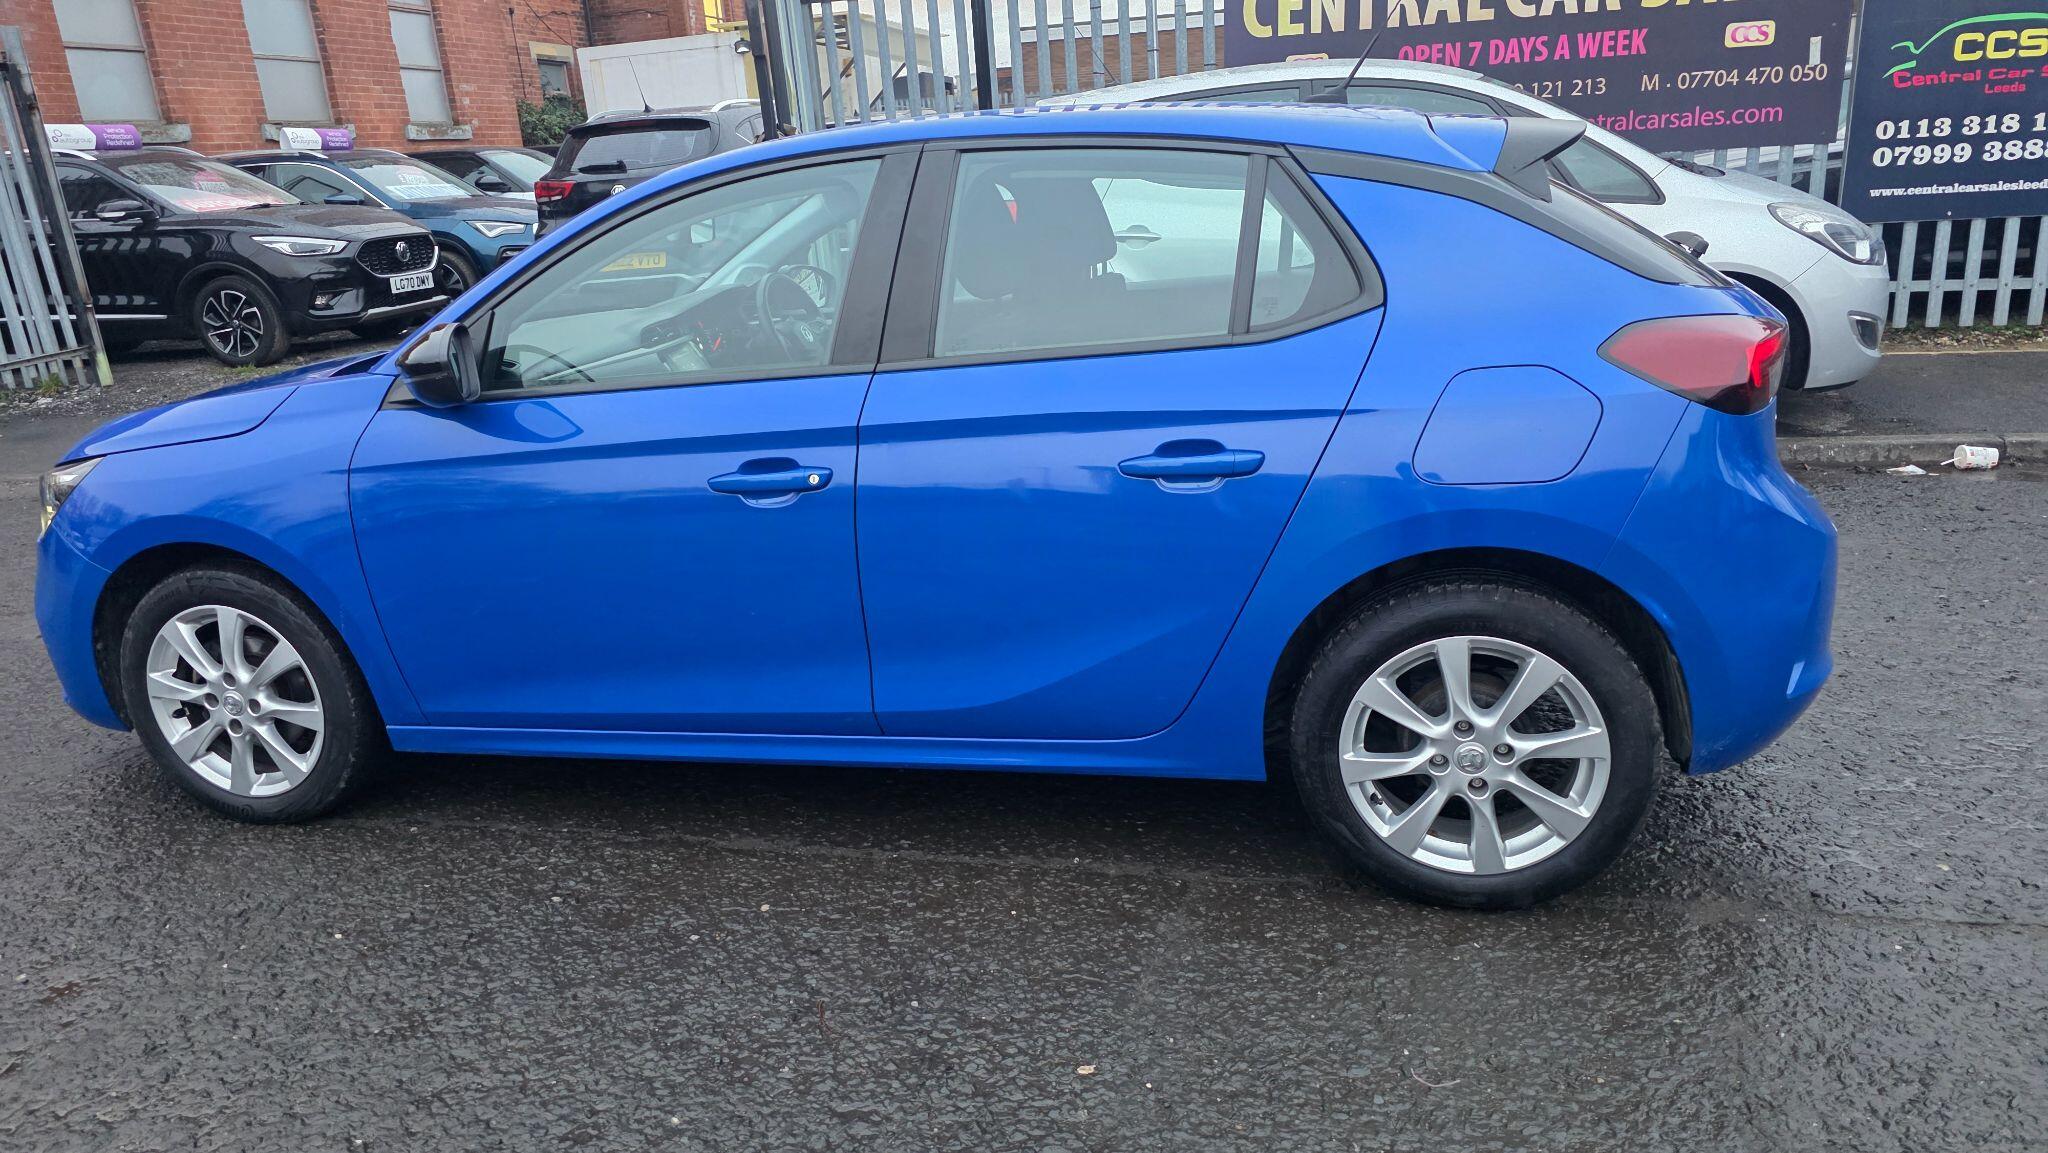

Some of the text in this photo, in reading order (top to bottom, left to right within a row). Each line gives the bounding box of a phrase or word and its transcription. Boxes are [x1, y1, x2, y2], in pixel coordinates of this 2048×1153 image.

[1398, 28, 1648, 67] OPEN 7 DAYS A WEEK
[1953, 28, 2048, 62] CCS
[1531, 81, 1562, 97] 121
[1571, 77, 1606, 96] 213
[1677, 69, 1739, 89] 07704
[1745, 66, 1783, 85] 470
[1789, 63, 1828, 83] 050
[1893, 69, 1981, 88] Central
[1988, 68, 2034, 80] Car
[1984, 82, 2026, 94] Leeds
[1875, 117, 1952, 140] 0113
[1961, 113, 2021, 135] 318
[1872, 138, 2048, 167] 07999 388
[395, 275, 430, 290] LG70 DMY
